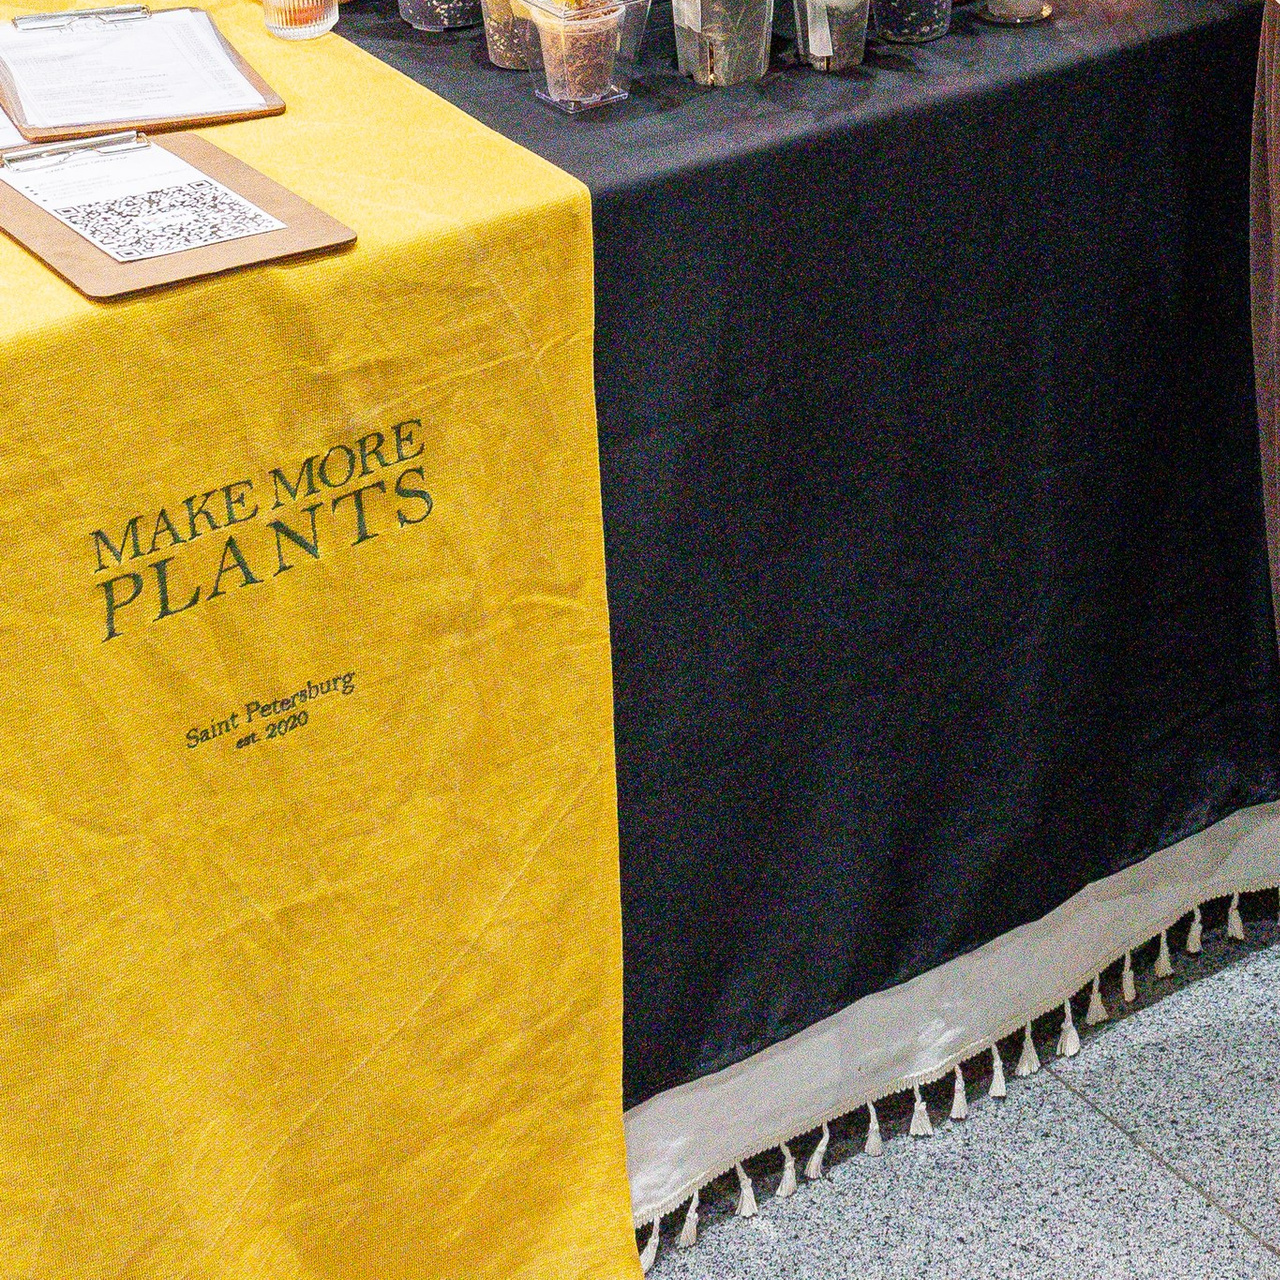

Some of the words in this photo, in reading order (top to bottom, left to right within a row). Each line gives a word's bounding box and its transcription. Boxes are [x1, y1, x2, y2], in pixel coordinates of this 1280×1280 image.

[90, 480, 259, 574] MAKE
[268, 418, 426, 510] MORE
[95, 466, 434, 643] PLANTS
[185, 712, 240, 749] Saint
[245, 671, 356, 724] Petersburg
[265, 710, 309, 740] 2020
